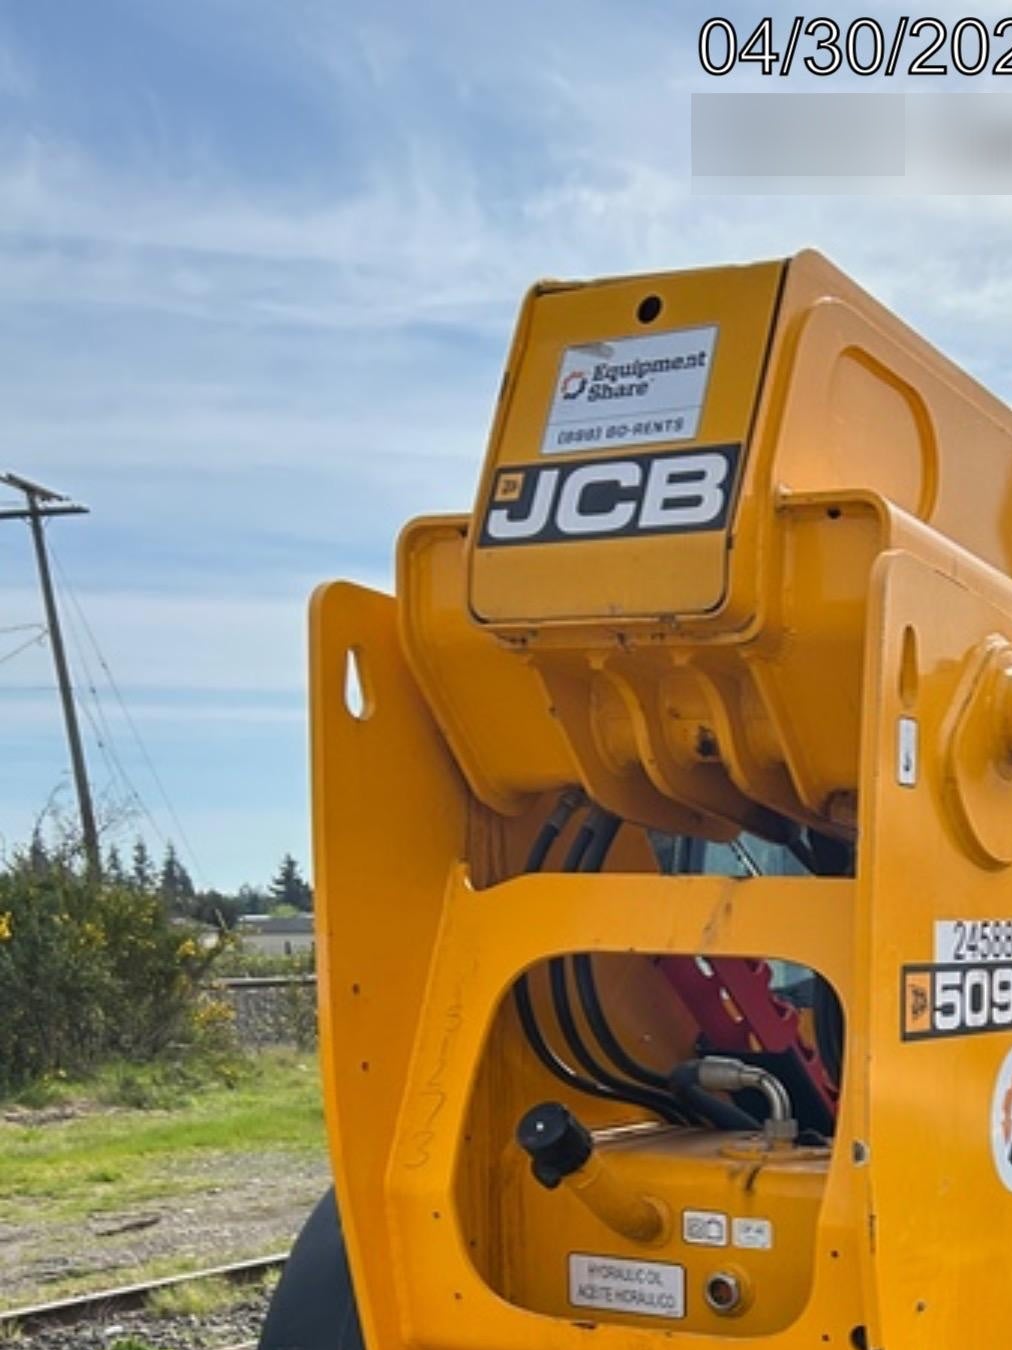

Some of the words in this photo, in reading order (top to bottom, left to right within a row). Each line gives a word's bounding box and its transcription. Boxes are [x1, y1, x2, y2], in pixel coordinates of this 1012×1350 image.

[592, 350, 707, 382] Equipment
[587, 380, 650, 402] Share
[487, 453, 728, 538] JCB
[587, 1262, 646, 1284] HYDRAULIC
